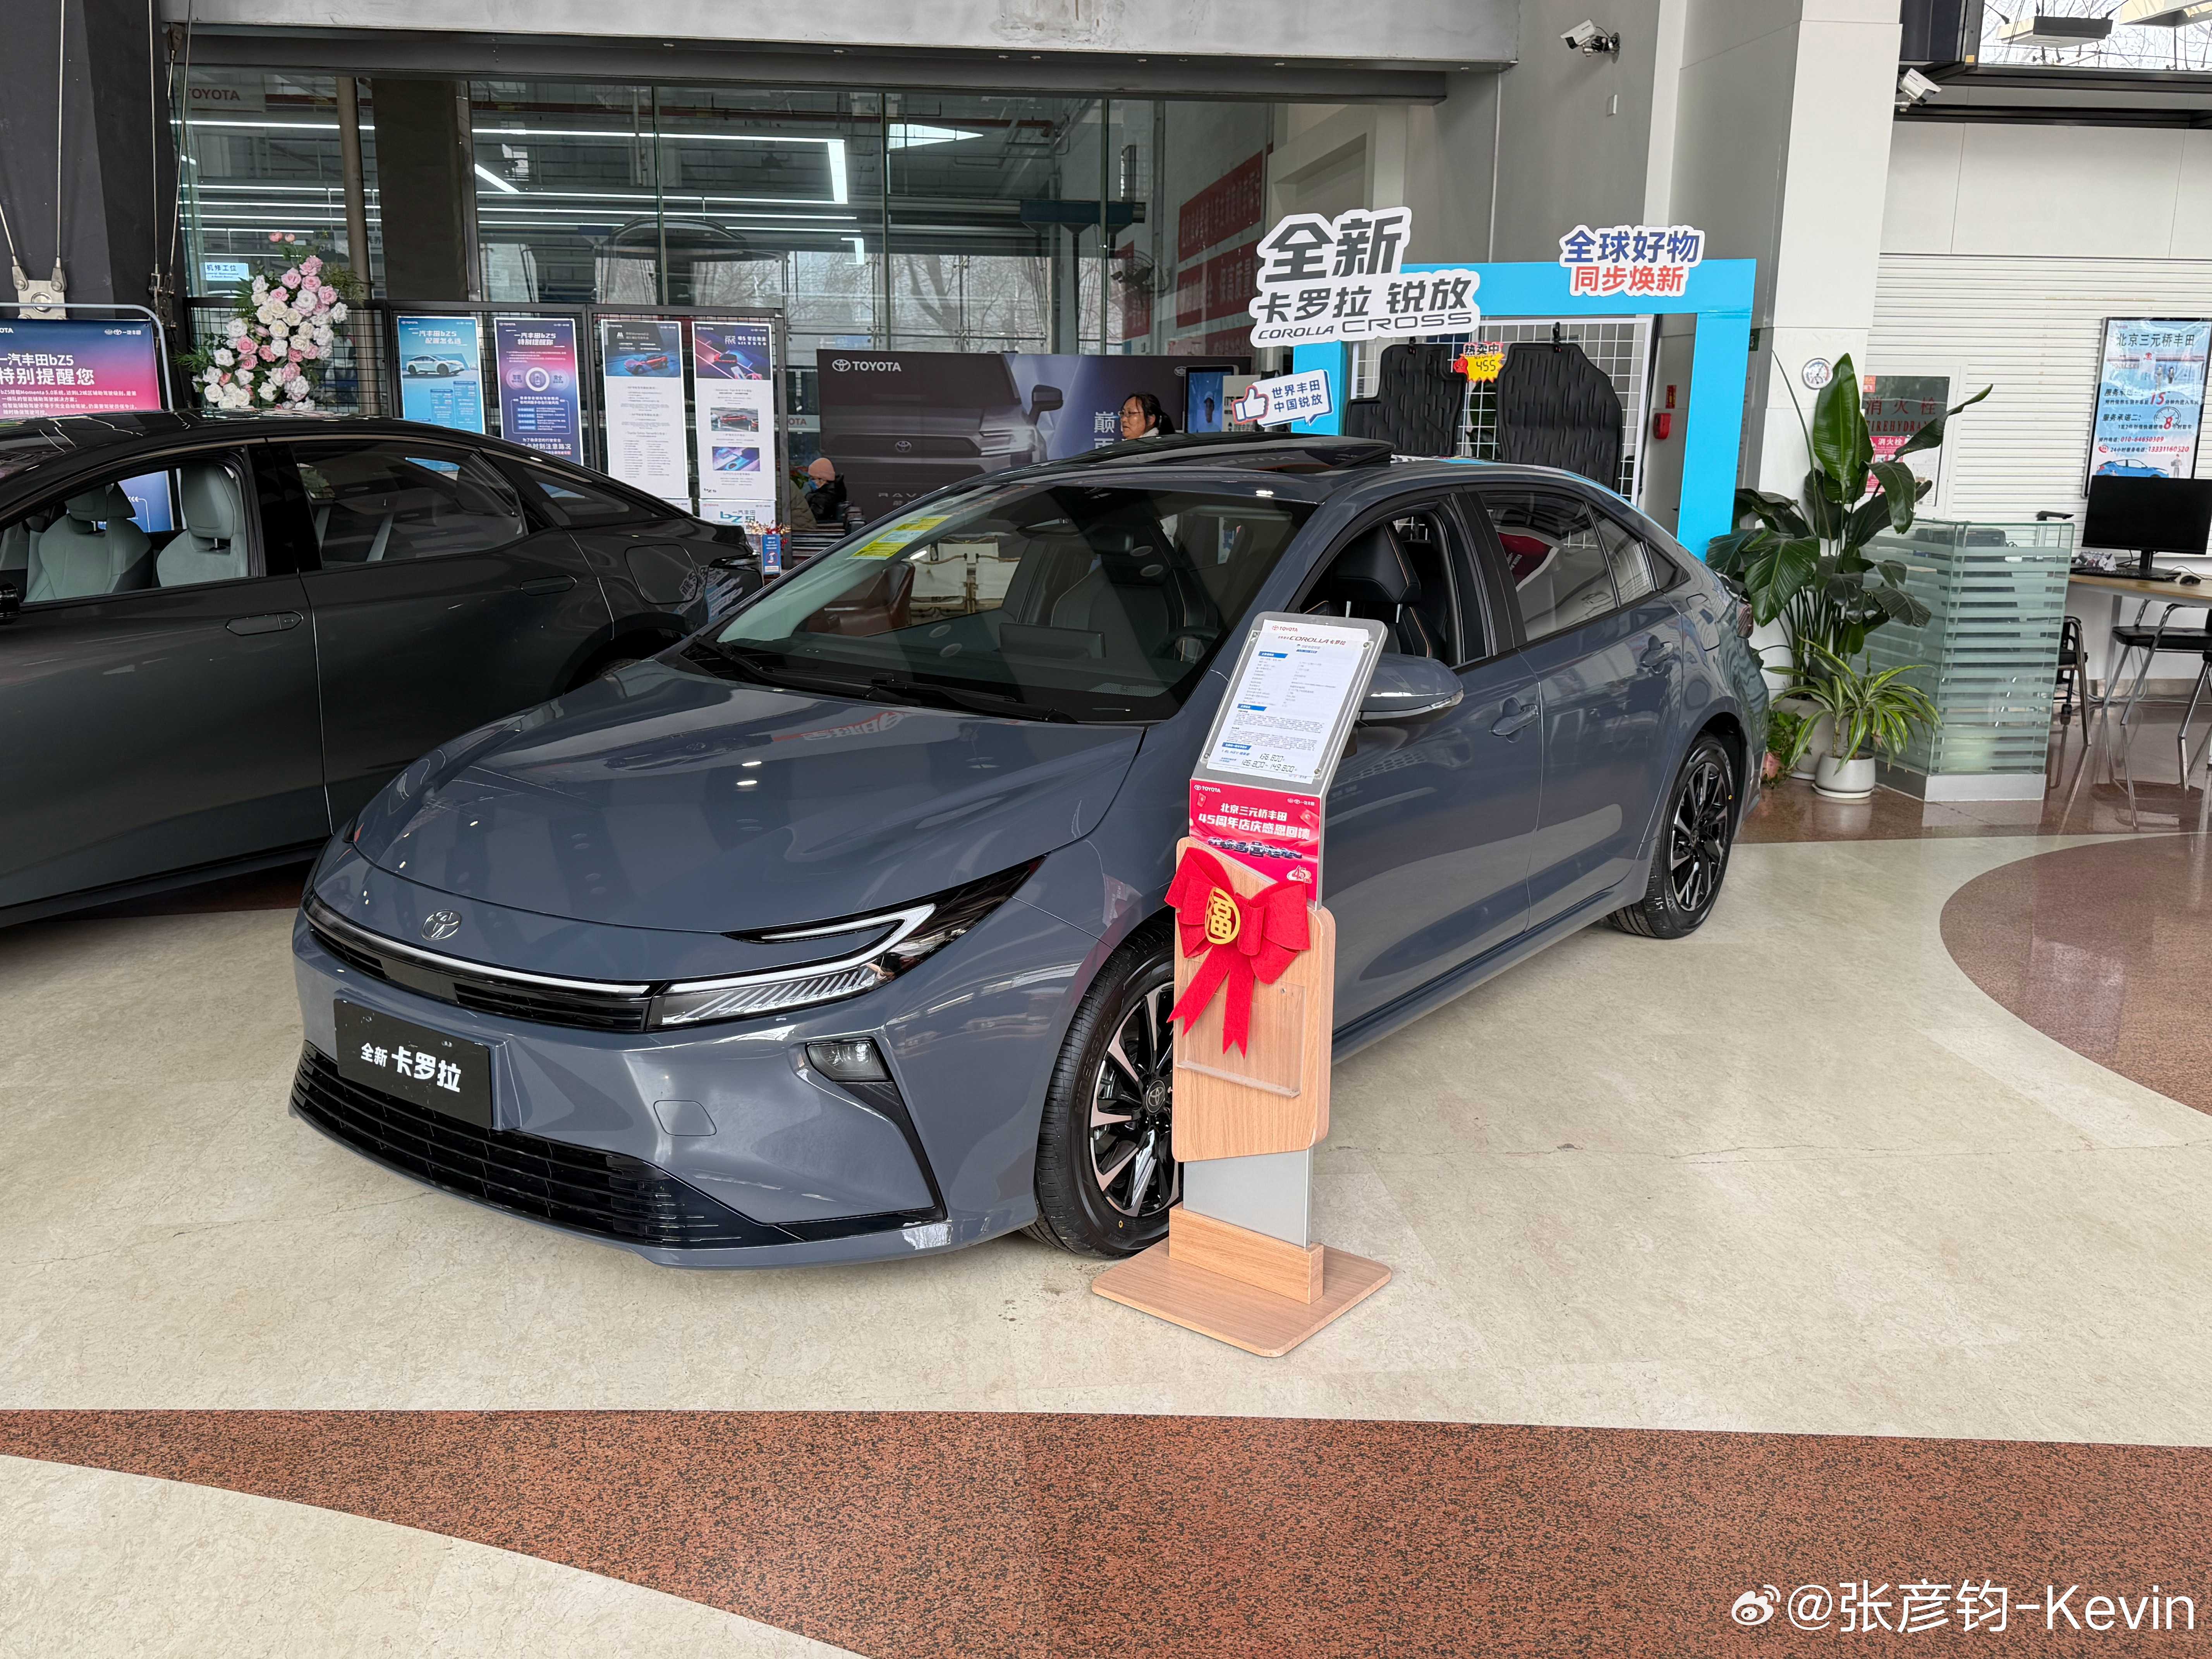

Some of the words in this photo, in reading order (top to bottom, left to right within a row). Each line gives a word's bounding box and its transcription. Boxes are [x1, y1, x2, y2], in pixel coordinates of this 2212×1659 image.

[189, 88, 240, 100] OYOTA
[1265, 215, 1403, 283] 全新
[1565, 230, 1700, 263] 全球好物
[1574, 265, 1684, 292] 同步焕新
[1257, 285, 1372, 324] 卡罗拉
[1386, 277, 1472, 314] 锐放
[1258, 325, 1334, 340] COROLLA
[1342, 311, 1472, 333] CROSS
[2117, 333, 2195, 347] 北京三元桥丰田
[852, 361, 902, 372] TOYOTA
[1476, 359, 1496, 372] 455
[0, 368, 95, 385] 特别提醒您
[1272, 380, 1320, 399] 世界丰田
[1274, 393, 1322, 412] 中国锐放
[1865, 396, 1936, 416] 消火栓
[1289, 635, 1329, 644] COROLLA
[1220, 802, 1288, 821] 北京三元桥丰田
[1198, 813, 1311, 840] 45周年店庆感恩回馈
[1205, 889, 1235, 941] 福
[361, 1042, 388, 1067] 全新
[391, 1046, 461, 1093] 卡罗拉
